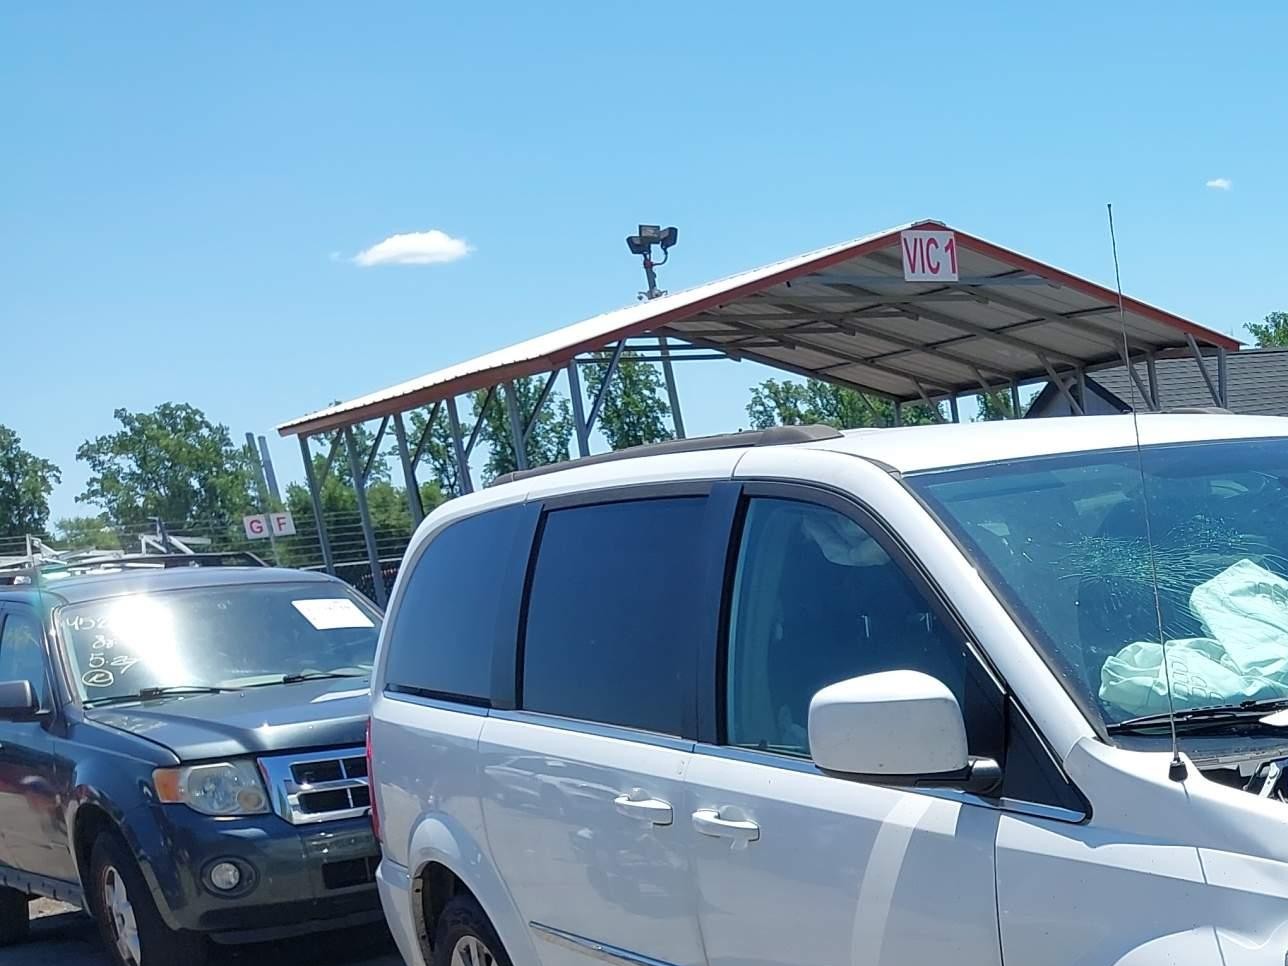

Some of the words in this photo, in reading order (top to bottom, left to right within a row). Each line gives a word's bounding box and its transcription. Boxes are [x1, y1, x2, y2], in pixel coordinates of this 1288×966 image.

[904, 238, 940, 274] VIC
[944, 238, 956, 274] 1
[250, 519, 264, 534] G
[276, 516, 287, 531] F
